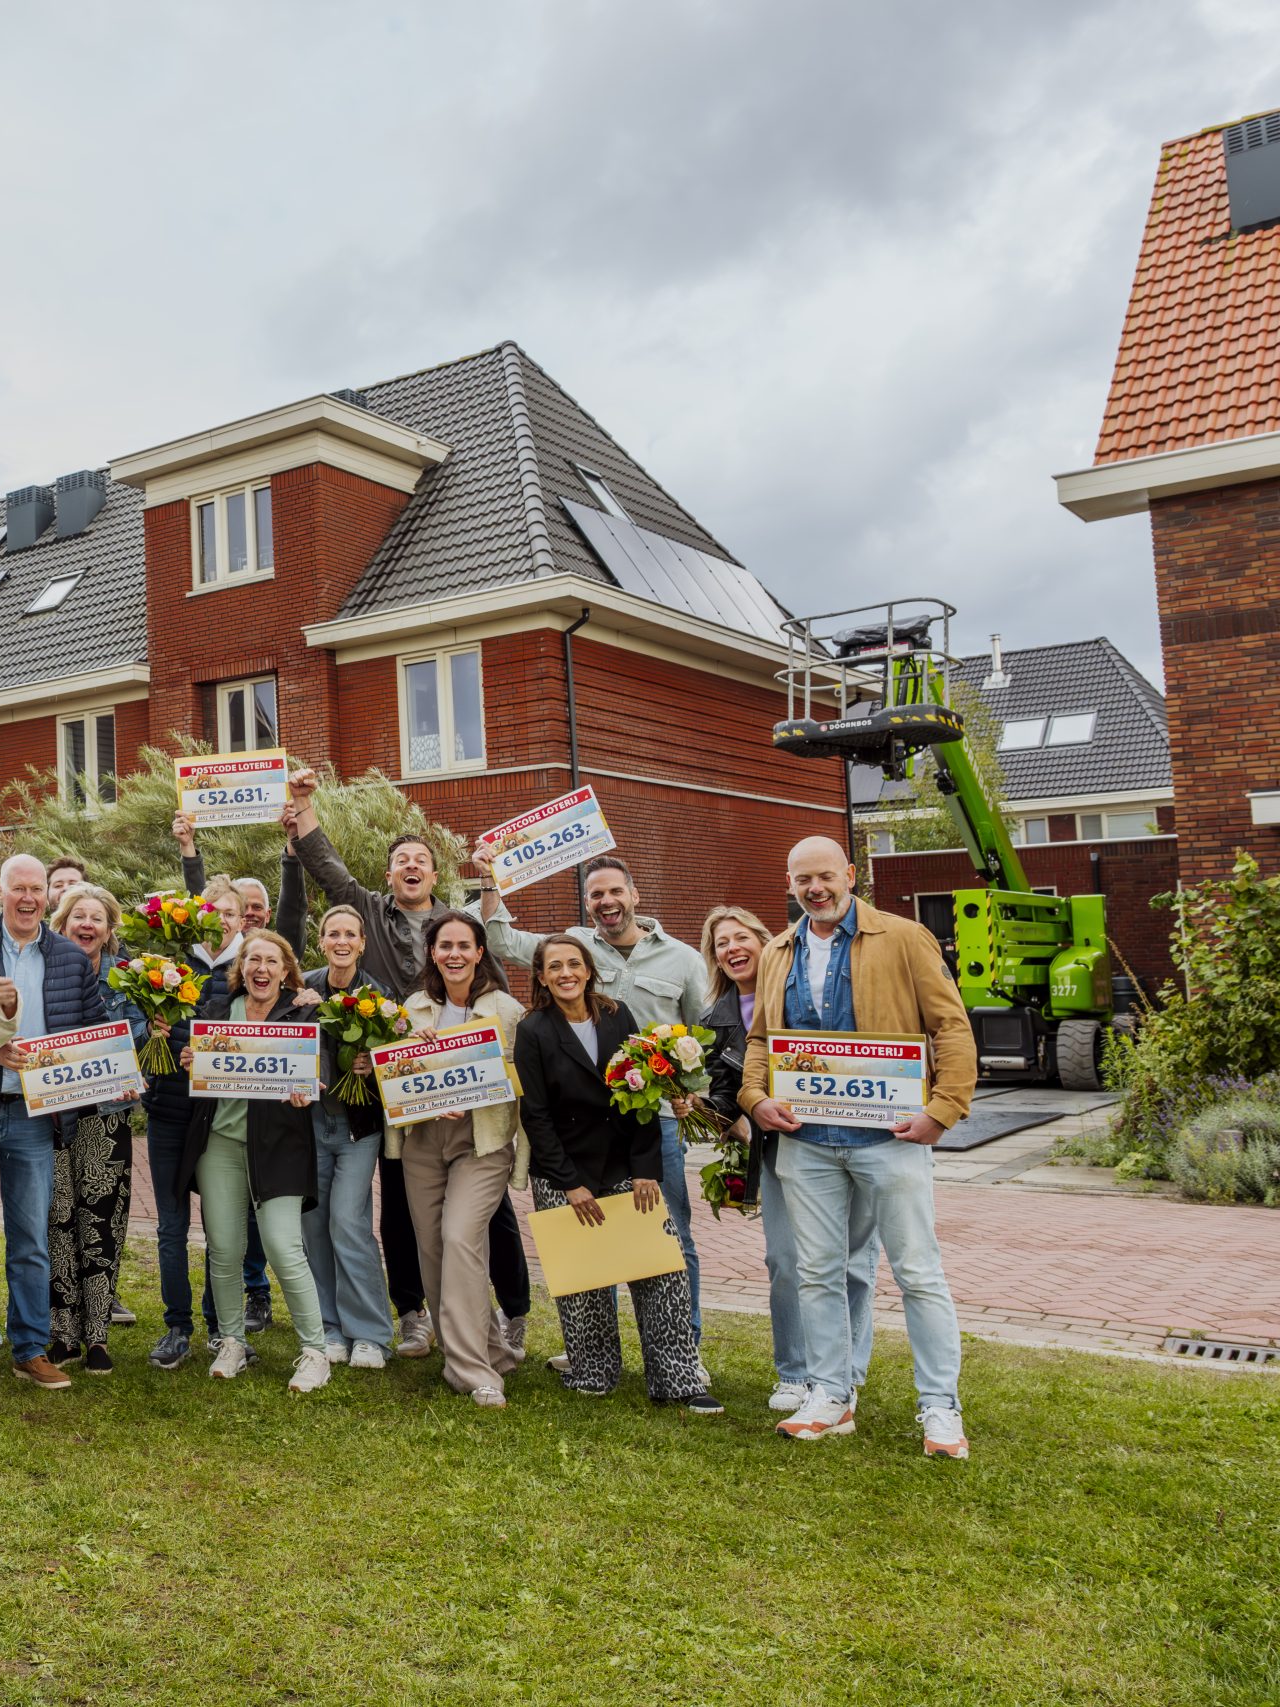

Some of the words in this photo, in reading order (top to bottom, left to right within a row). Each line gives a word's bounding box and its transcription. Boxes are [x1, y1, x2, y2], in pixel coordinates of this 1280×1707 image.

[829, 719, 872, 730] DOORNBOS
[191, 764, 237, 774] POSTCODE
[238, 762, 272, 770] LOTERIJ
[198, 794, 205, 804] €
[209, 788, 269, 805] 52.631,-
[494, 813, 541, 839] POSTCODE
[542, 796, 578, 816] LOTERIJ
[504, 856, 512, 866] €
[513, 823, 590, 863] 105.263,-
[1052, 985, 1077, 996] 3277
[30, 1035, 79, 1051] POSTCODE
[80, 1028, 116, 1041] LOTERIJ
[208, 1026, 260, 1035] POSTCODE
[263, 1028, 303, 1036] LOTERIJ
[388, 1041, 441, 1060] POSTCODE
[443, 1034, 482, 1049] LOTERIJ
[788, 1043, 852, 1055] POSTCODE
[855, 1045, 903, 1056] LOTERIJ
[42, 1073, 51, 1084] €
[53, 1058, 118, 1085] 52.631,-
[212, 1058, 220, 1069] €
[224, 1056, 297, 1075] 52.631,-
[402, 1081, 411, 1093] €
[413, 1066, 485, 1094] 52.631,-
[796, 1079, 805, 1091] €
[810, 1077, 898, 1101] 52.631,-
